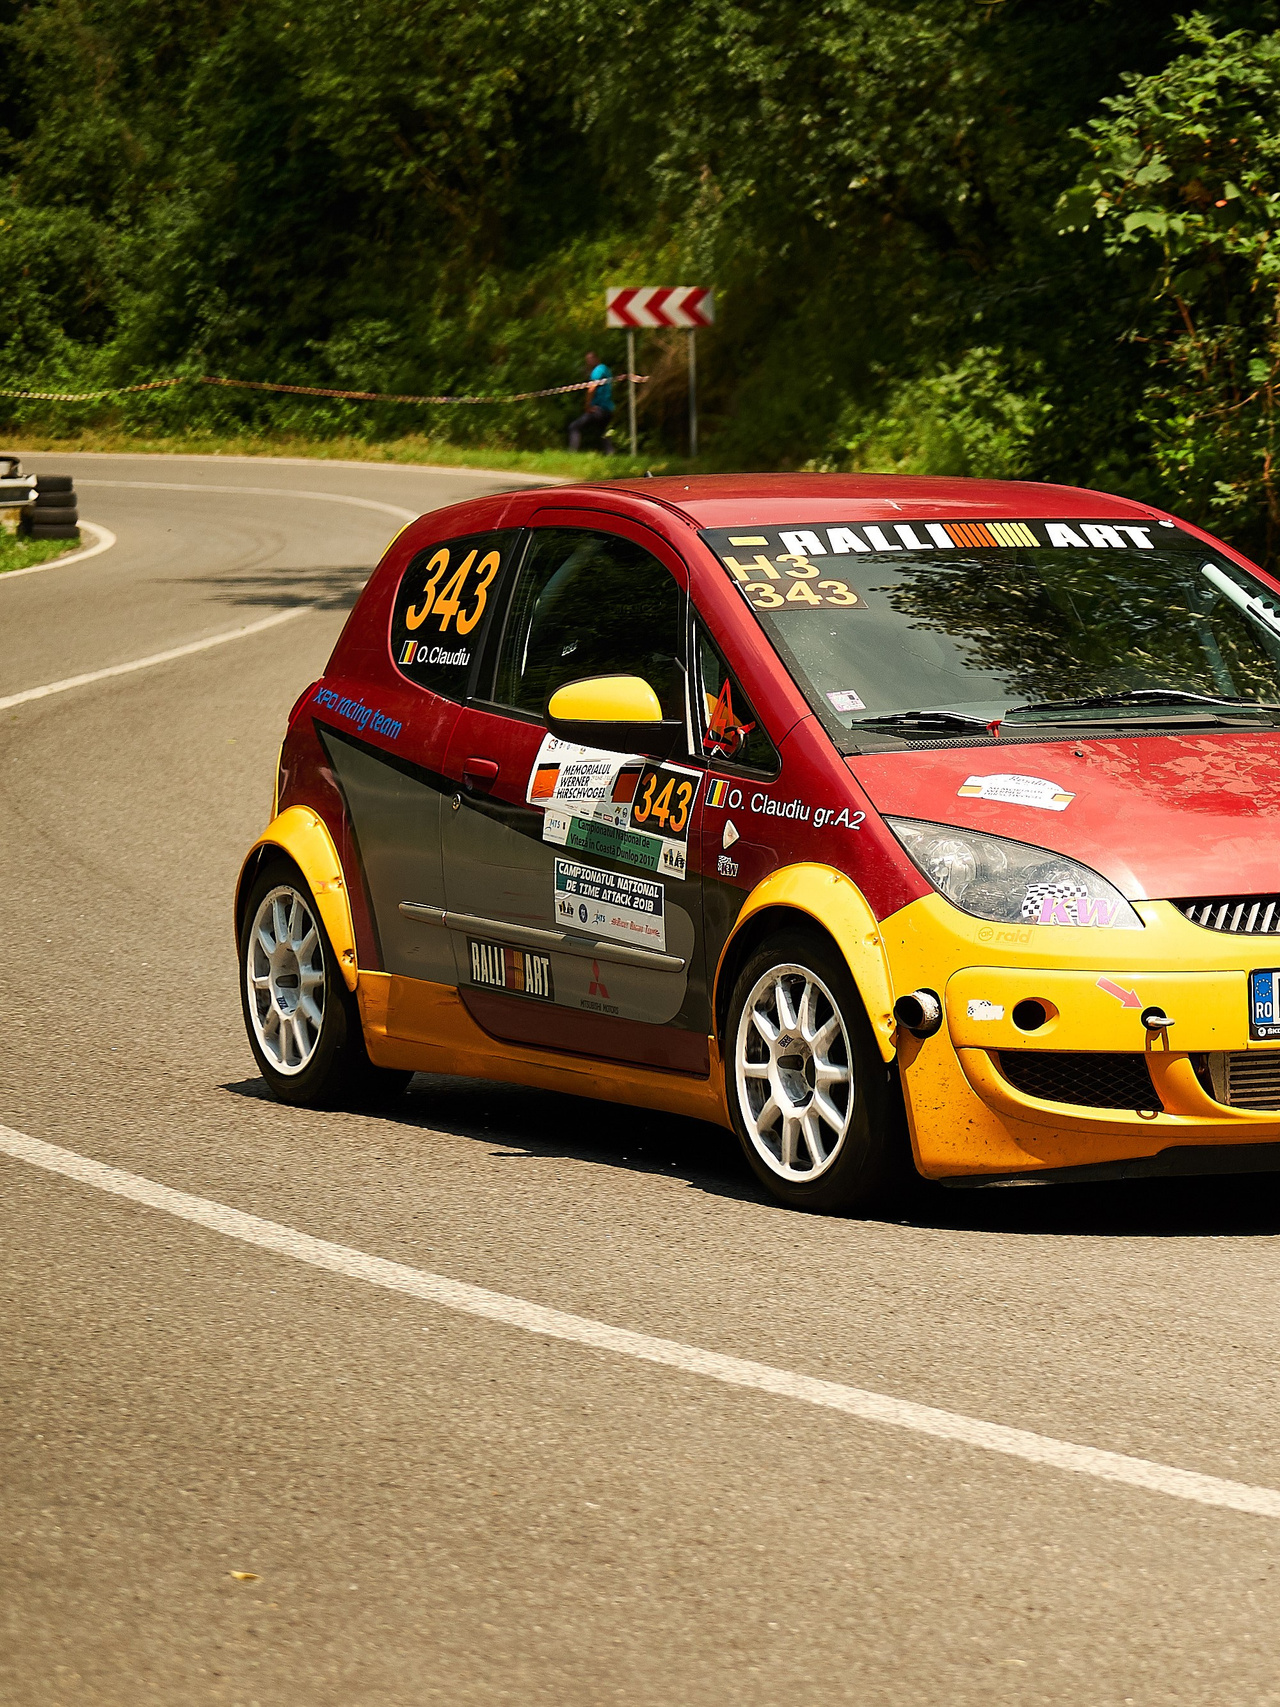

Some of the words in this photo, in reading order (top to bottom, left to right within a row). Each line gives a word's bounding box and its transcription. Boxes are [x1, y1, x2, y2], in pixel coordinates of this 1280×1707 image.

[778, 523, 956, 557] RALLI
[1044, 523, 1155, 549] ART
[721, 553, 821, 581] H3
[405, 548, 501, 635] 343
[743, 580, 858, 608] 343
[417, 645, 471, 666] O.Claudiu
[335, 697, 373, 731] racing
[369, 708, 403, 740] team
[559, 775, 591, 788] WERNER
[562, 763, 612, 776] MEMORIALUL
[556, 786, 606, 800] HIRSCHVOGEL
[634, 772, 693, 832] 343
[728, 788, 745, 810] O.
[750, 792, 811, 822] Claudiu
[812, 807, 867, 831] gr.A2
[577, 819, 615, 839] Campionatul
[642, 838, 650, 849] de
[616, 844, 639, 862] Dunlop
[640, 854, 656, 867] 2017
[558, 862, 616, 888] CAMPIONATUL
[565, 879, 578, 893] DE
[580, 882, 601, 898] TIME
[601, 888, 633, 907] ATTACK
[633, 896, 655, 912] 2018
[471, 941, 506, 987] RALLI
[525, 953, 550, 997] ART
[1256, 1002, 1272, 1018] RO
